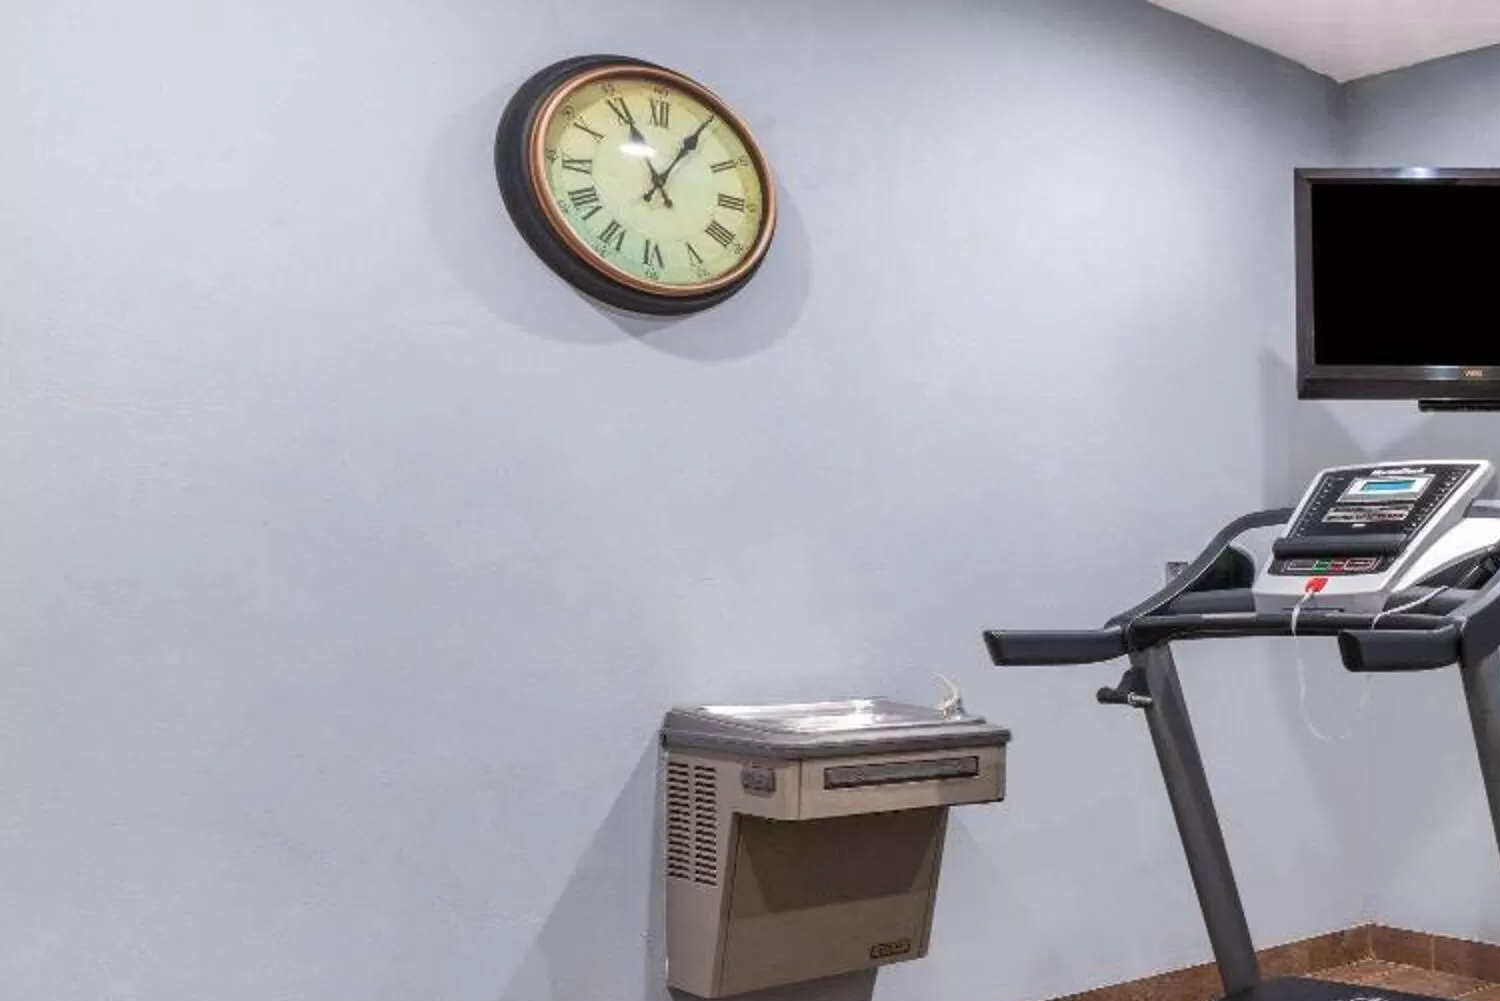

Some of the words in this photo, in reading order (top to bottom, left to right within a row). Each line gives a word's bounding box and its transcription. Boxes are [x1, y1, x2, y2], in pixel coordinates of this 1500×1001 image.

[648, 97, 669, 128] XII
[710, 160, 737, 173] II
[568, 186, 603, 220] VIII
[717, 193, 744, 212] III
[598, 219, 627, 251] VII
[642, 240, 665, 268] VI
